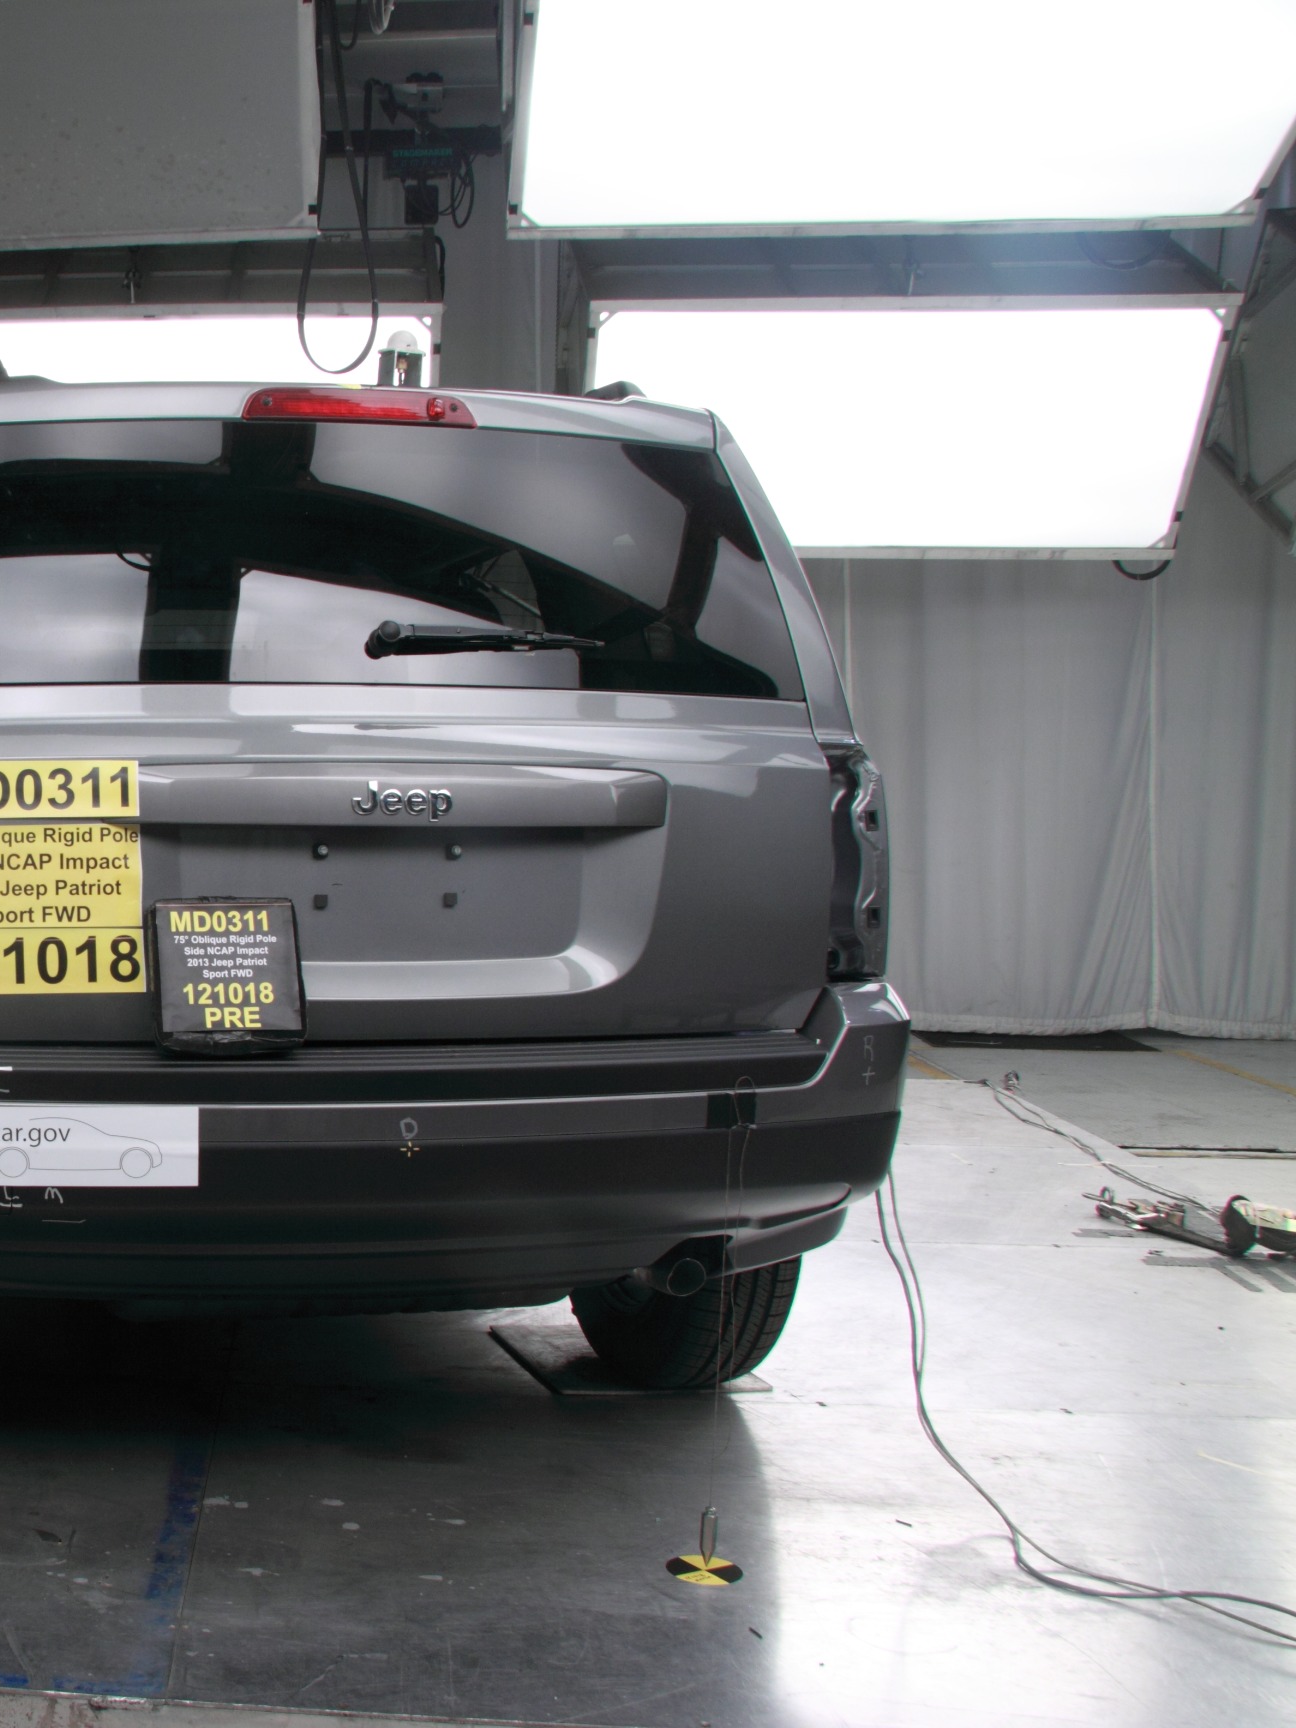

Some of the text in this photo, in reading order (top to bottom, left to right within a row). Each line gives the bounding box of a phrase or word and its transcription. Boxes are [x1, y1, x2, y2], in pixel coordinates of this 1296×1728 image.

[351, 780, 453, 821] Jeep
[44, 827, 93, 846] Rigid
[100, 827, 139, 843] Pole
[60, 853, 130, 873] Impact
[0, 881, 48, 900] Jeep
[55, 880, 122, 896] Patriot
[42, 906, 91, 922] FWD
[169, 910, 268, 932] MD0311
[173, 934, 277, 945] 75° Oblique Rigid Pole
[184, 946, 268, 956] Side NCAP Impact
[187, 957, 267, 968] 2013 Jeep Patriot
[202, 969, 253, 979] Sport FWD
[183, 982, 274, 1004] 121018
[205, 1006, 261, 1028] PRE
